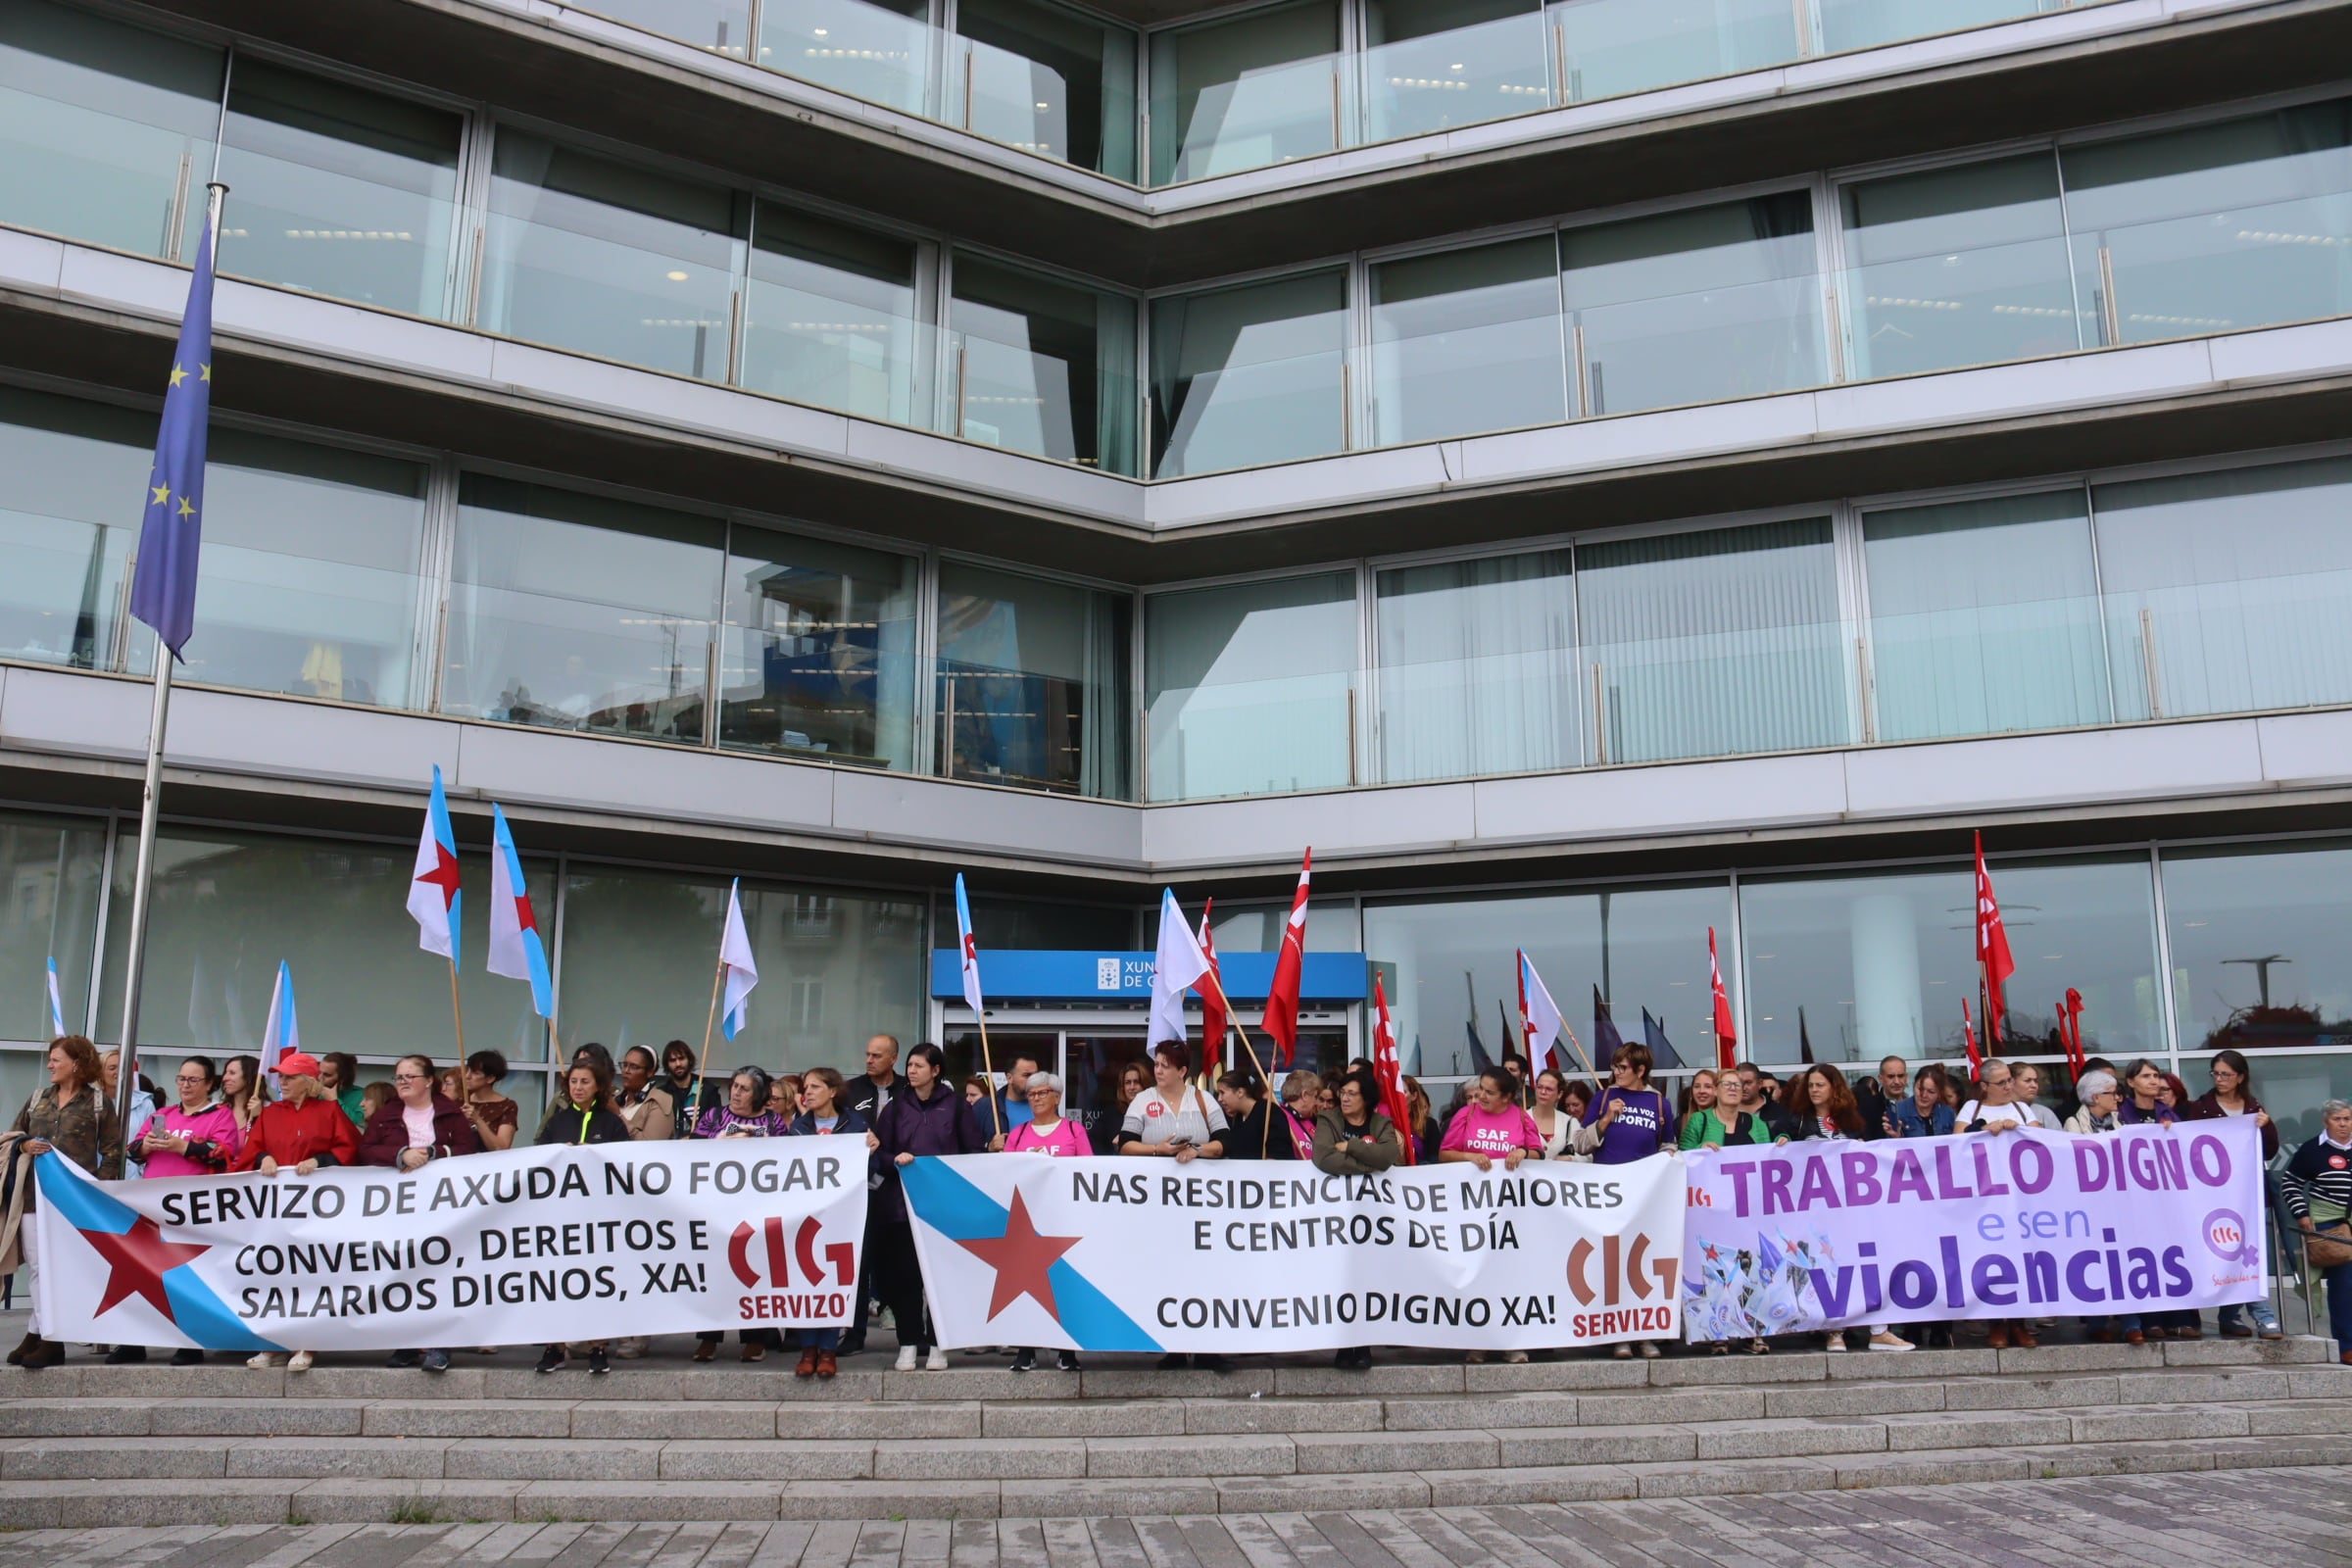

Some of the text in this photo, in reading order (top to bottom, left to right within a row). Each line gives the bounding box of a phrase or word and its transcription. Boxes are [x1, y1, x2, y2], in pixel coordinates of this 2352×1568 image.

[1124, 975, 1143, 988] DE
[1125, 961, 1154, 973] XUN
[1614, 1114, 1656, 1131] PORTA
[1622, 1105, 1655, 1118] OSA VOZ
[1476, 1128, 1509, 1141] SAF
[162, 1156, 841, 1226] SERVIZO DE AXUDA NO FOGAR
[1072, 1171, 1624, 1213] NAS RESIDENCIAS DE MAIORES
[1720, 1134, 2232, 1218] TRABALLO DIGNO
[1688, 1186, 1711, 1206] IG
[1195, 1212, 1519, 1252] E CENTROS DE DÍA
[1978, 1209, 2091, 1242] e sen
[2213, 1227, 2240, 1245] CIG
[235, 1219, 710, 1275] CONVENIO, DEREITOS E
[727, 1214, 856, 1290] CIG
[1566, 1232, 1679, 1307] CIG
[1808, 1227, 2193, 1319] violencias
[238, 1262, 708, 1319] SALARIOS DIGNOS, XA!
[739, 1292, 846, 1320] SERVIZO
[1156, 1292, 1556, 1329] CONVENIO DIGNO XA!
[1572, 1305, 1672, 1339] SERVIZO
